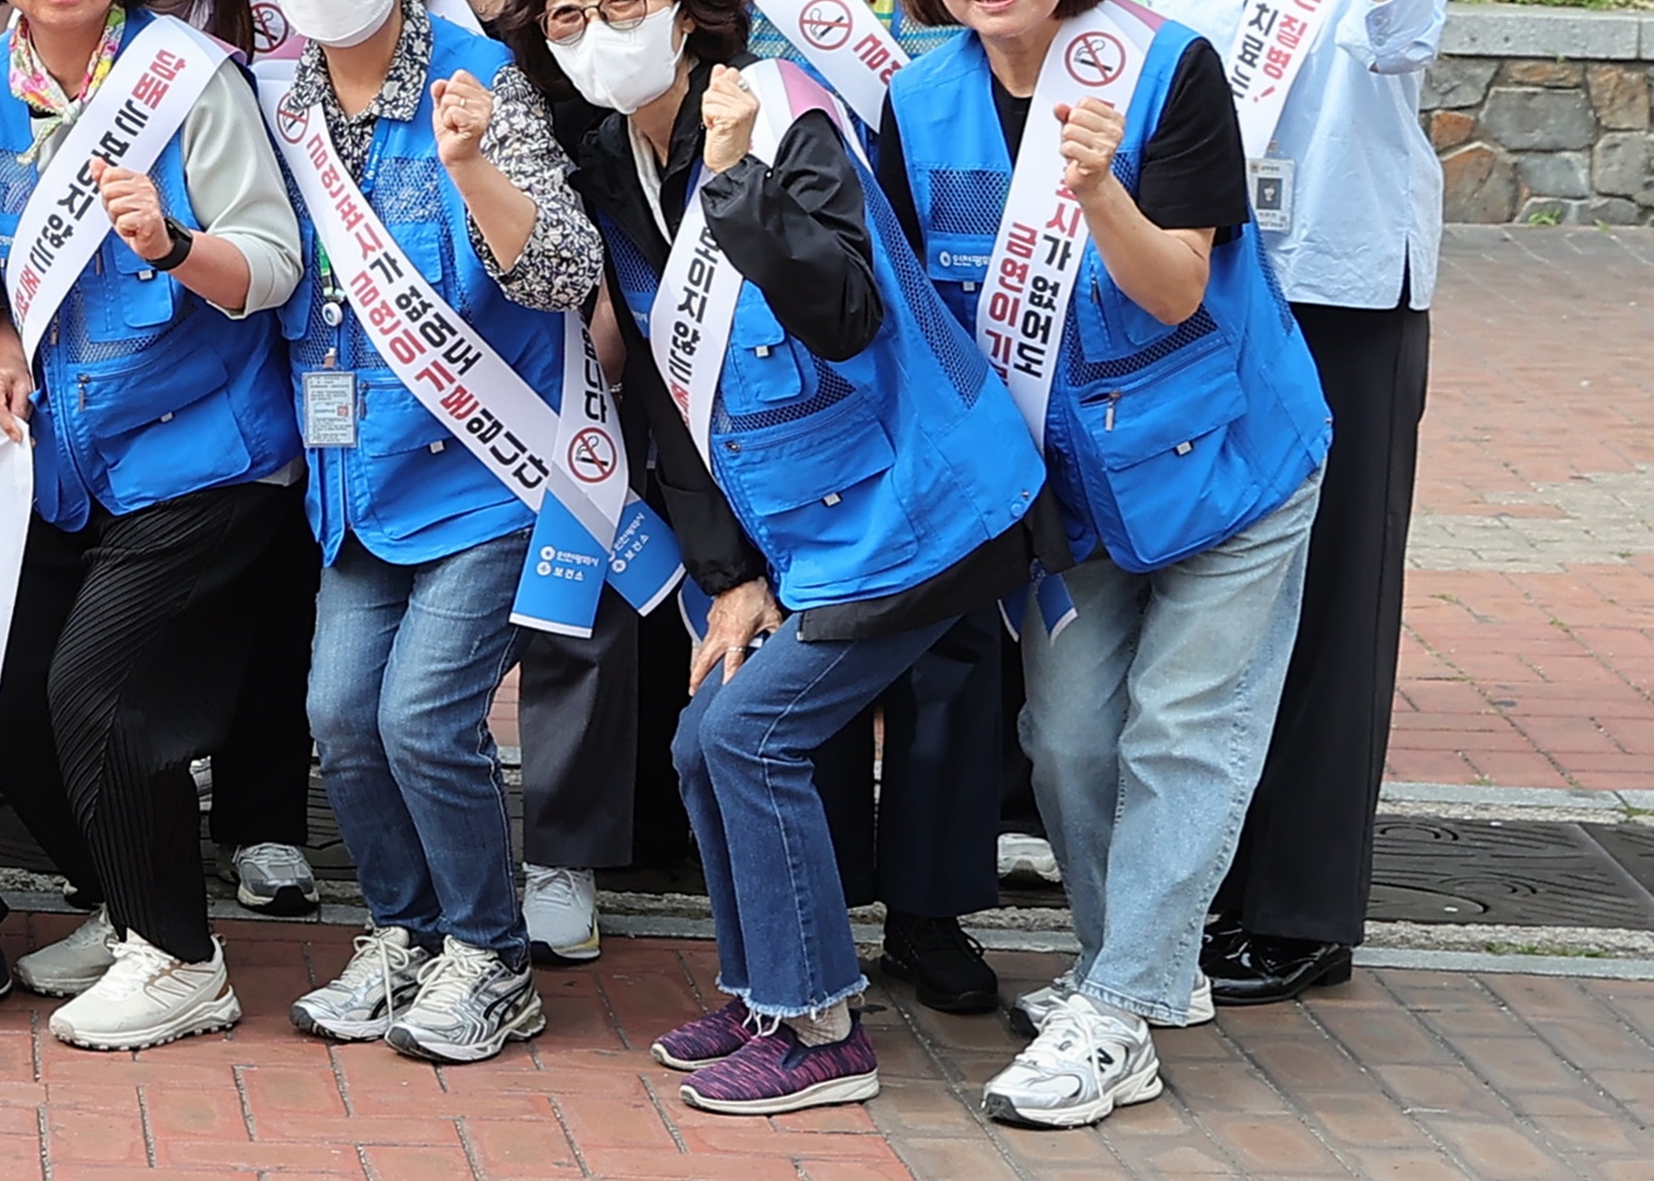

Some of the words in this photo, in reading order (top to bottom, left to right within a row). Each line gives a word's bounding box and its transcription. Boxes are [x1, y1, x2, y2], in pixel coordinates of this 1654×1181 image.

[116, 49, 187, 135] 담배는
[1252, 14, 1309, 104] 질병!
[29, 212, 80, 277] 않는
[305, 133, 406, 286] 금연표시가
[393, 290, 486, 377] 없어도
[985, 223, 1038, 328] 금연이
[1013, 275, 1060, 380] 없어도
[349, 270, 426, 366] 금연이
[413, 360, 552, 492] 기본입니다
[552, 566, 585, 582] 보건소
